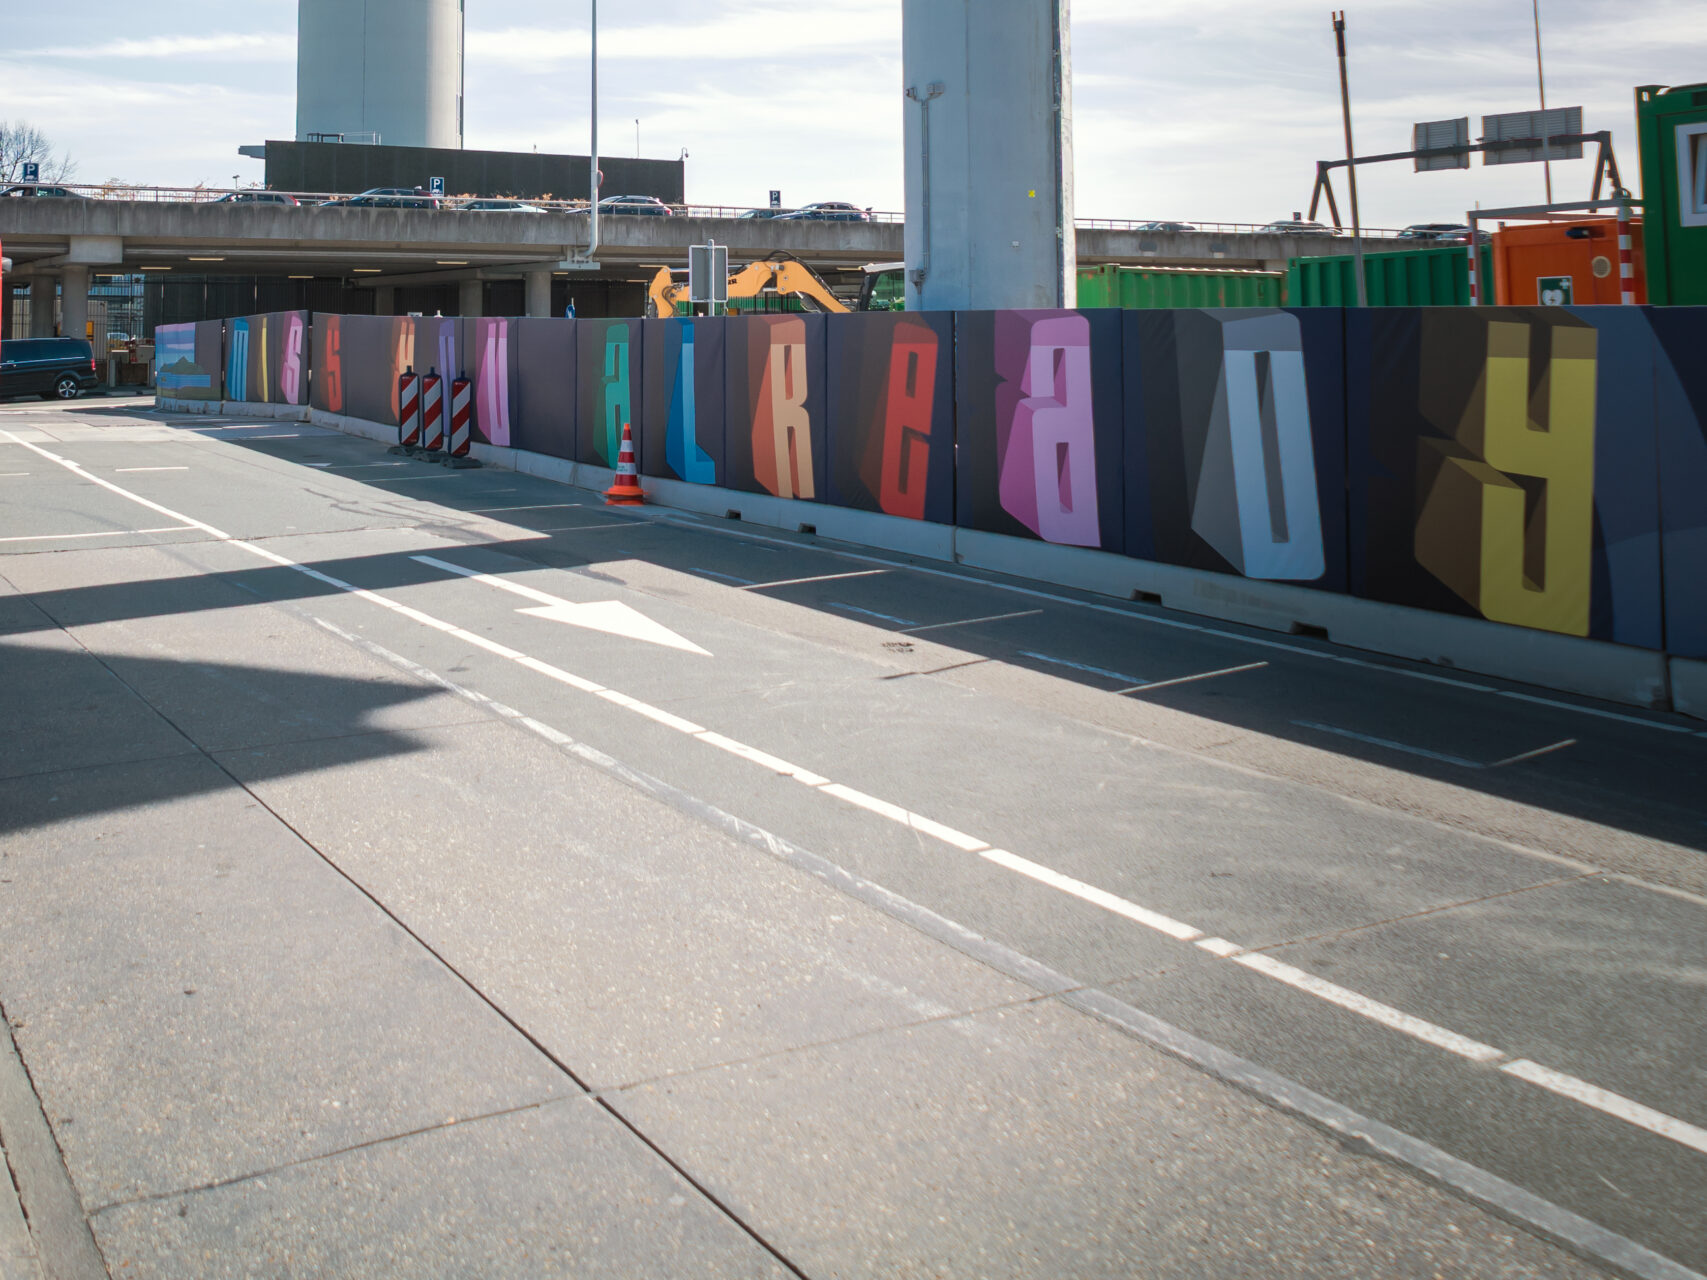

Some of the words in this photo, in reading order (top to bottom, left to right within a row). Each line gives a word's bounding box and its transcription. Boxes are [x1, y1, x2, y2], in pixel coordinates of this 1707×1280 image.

[27, 164, 35, 175] P
[433, 178, 441, 188] P
[772, 191, 778, 200] P
